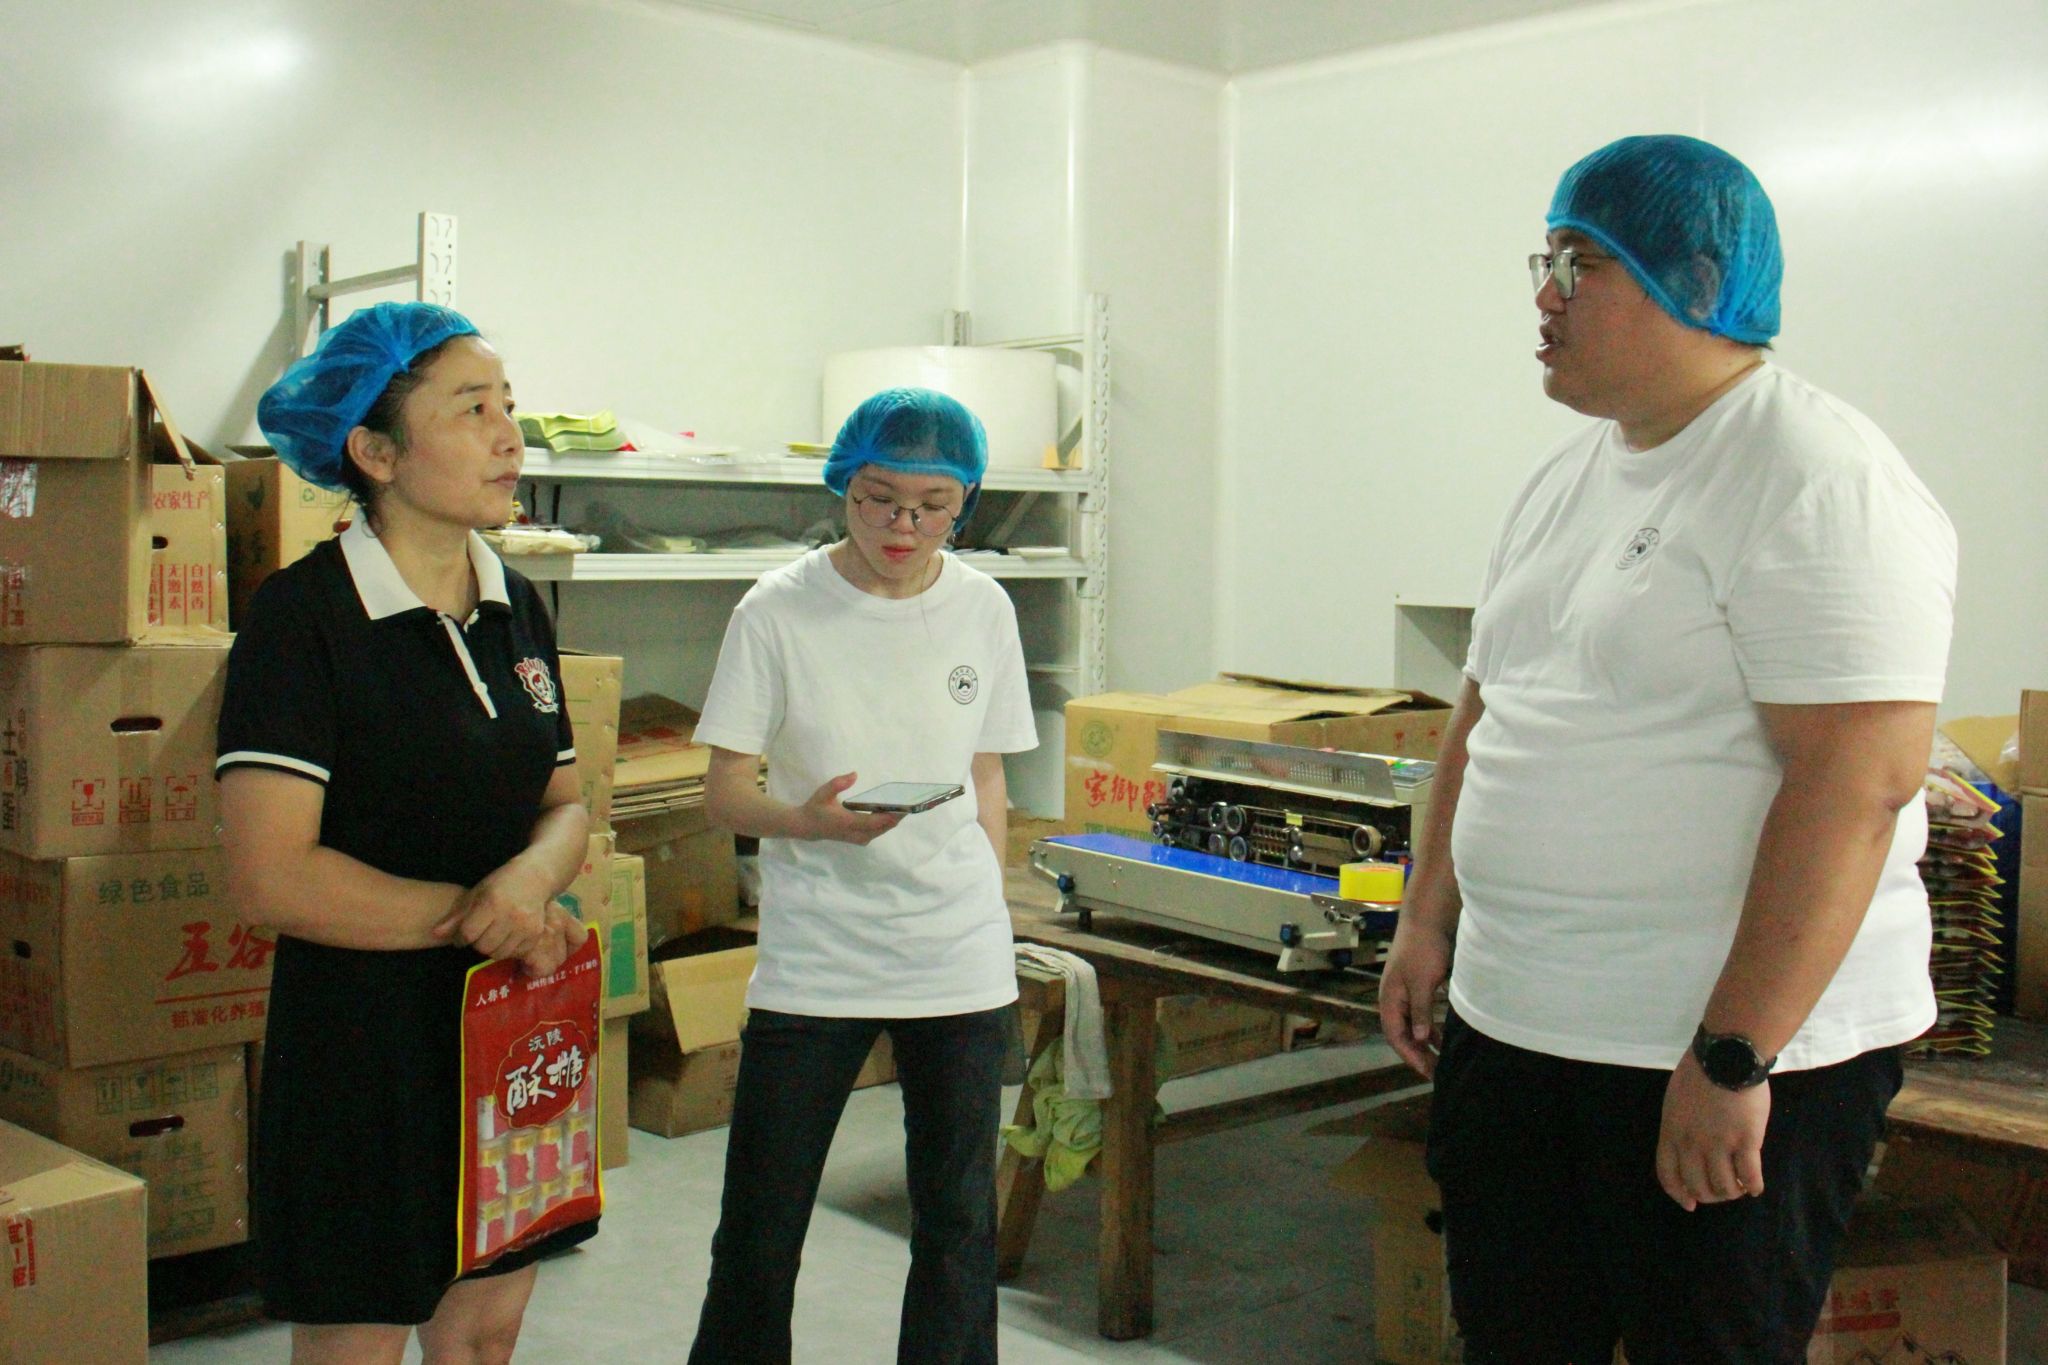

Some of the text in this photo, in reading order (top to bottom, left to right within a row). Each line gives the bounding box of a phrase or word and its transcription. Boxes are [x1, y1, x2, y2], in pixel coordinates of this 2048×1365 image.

[154, 490, 209, 510] 农家生产
[99, 872, 210, 905] 绿色食品
[528, 1028, 564, 1052] 沅陵
[505, 1045, 585, 1116] 酥糖
